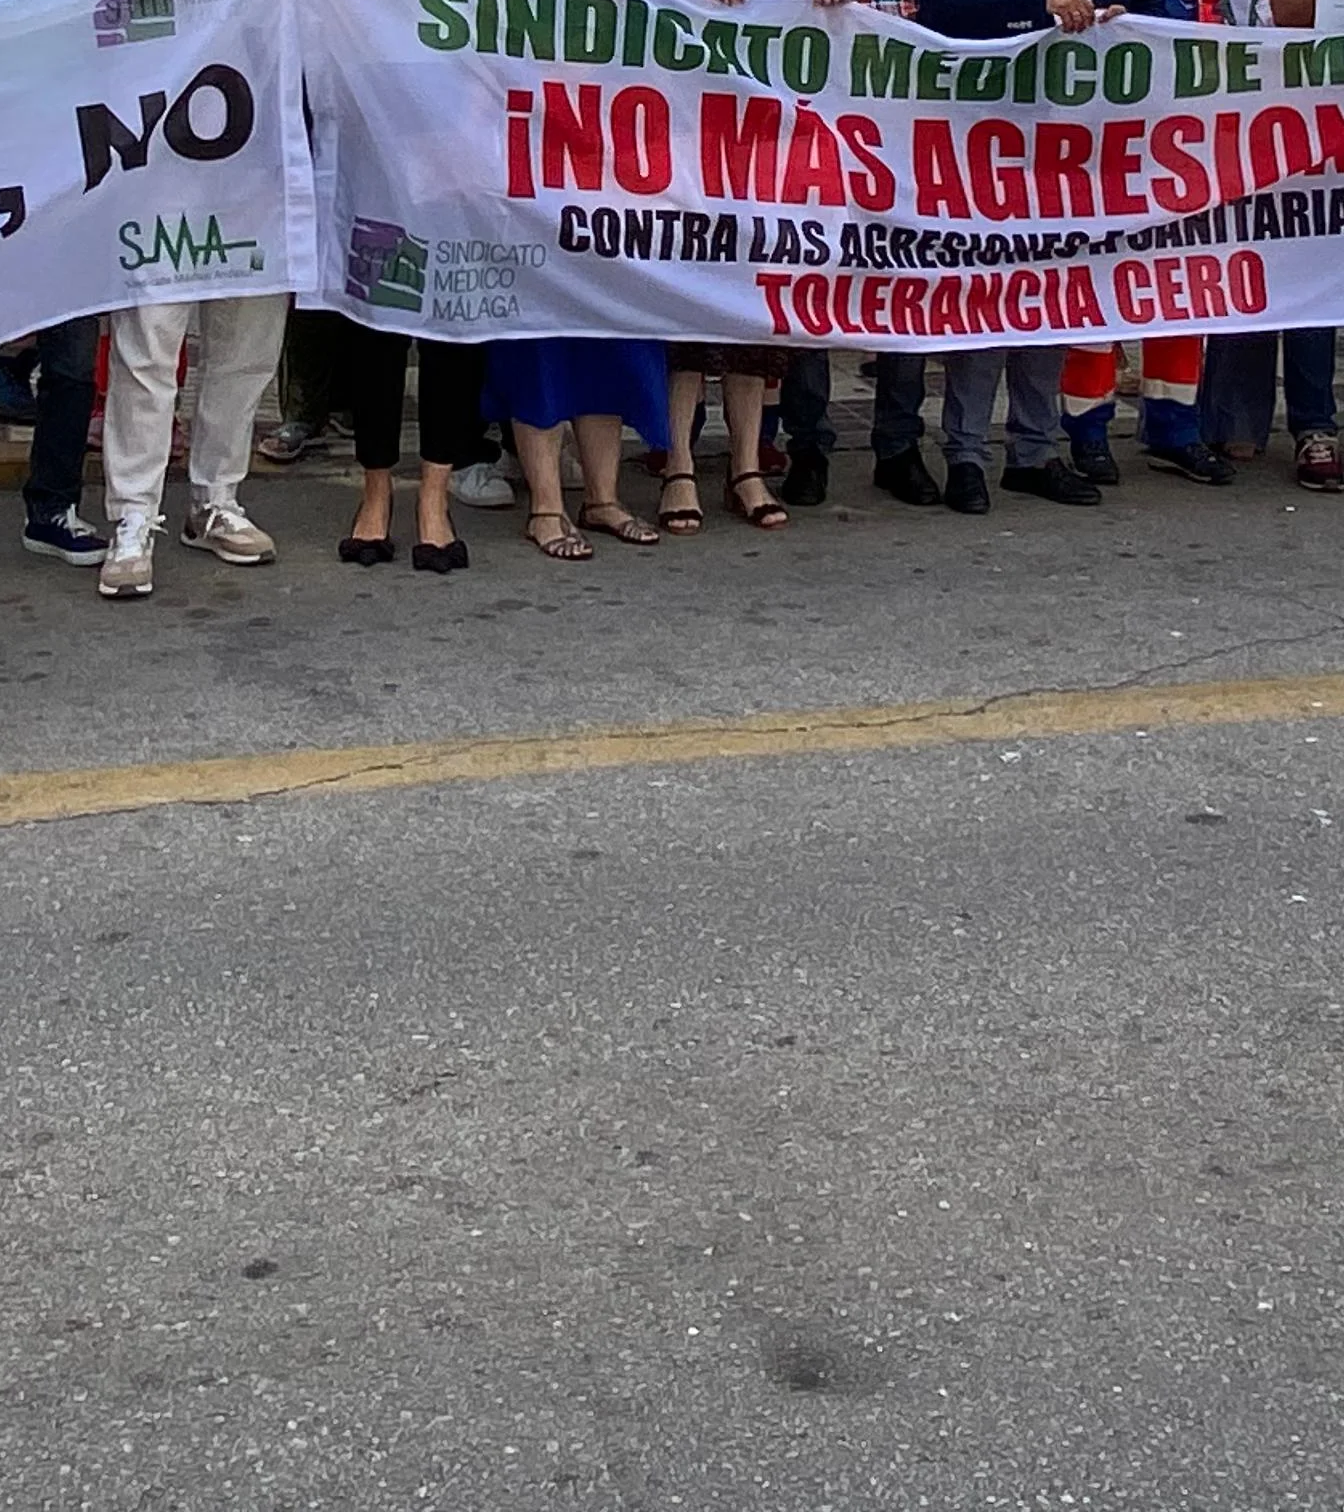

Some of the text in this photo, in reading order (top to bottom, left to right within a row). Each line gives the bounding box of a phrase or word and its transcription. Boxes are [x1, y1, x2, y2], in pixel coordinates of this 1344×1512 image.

[1174, 38, 1262, 99] DE
[76, 64, 254, 195] NO
[506, 81, 673, 198] ¡NO
[701, 93, 895, 212] MÁS
[119, 212, 228, 272] SMA
[435, 240, 547, 268] SINDICATO
[558, 205, 738, 262] CONTRA
[749, 215, 831, 266] LAS
[839, 222, 1090, 269] AGRESIONES
[432, 294, 520, 321] MÁLAGA
[434, 264, 515, 293] MÉDICO
[756, 249, 1268, 336] TOLERANCIA CERO
